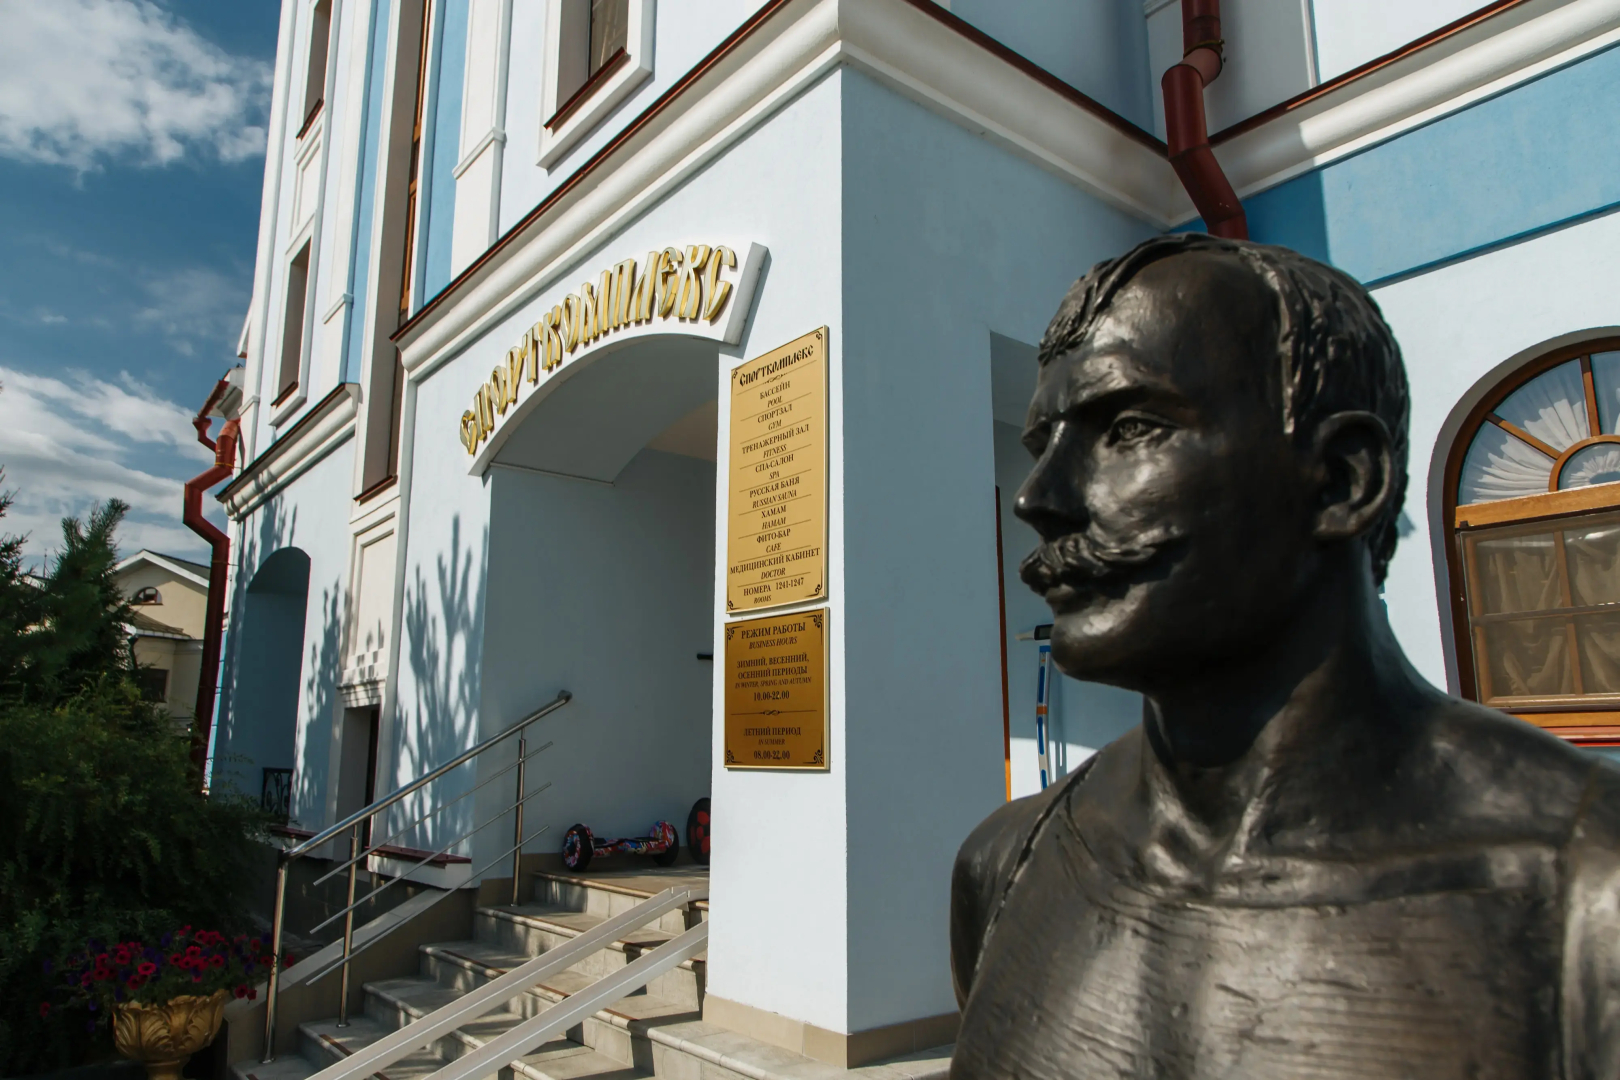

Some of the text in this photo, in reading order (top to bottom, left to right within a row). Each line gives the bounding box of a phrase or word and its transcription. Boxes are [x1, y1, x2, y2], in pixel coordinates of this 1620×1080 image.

[460, 244, 736, 455] СПОРТКОМПЛЕКС
[760, 381, 790, 399] БАССЕЙН
[767, 396, 782, 407] POOL
[758, 404, 792, 423] СПОРТЗАЛ
[768, 419, 781, 430] GYM
[742, 424, 809, 454] ТРЕНАЖЕРНЫЙ ЗАЛ
[763, 444, 787, 458] FITNESS
[755, 454, 794, 473] СПА-САЛОН
[769, 471, 779, 480] SPA
[749, 476, 800, 498] РУССКАЯ БАНЯ
[752, 490, 797, 509] RUSSIAN SAUNA
[761, 505, 787, 518] ХАМАМ
[762, 517, 786, 530] HAMAM
[757, 529, 790, 543] ФИТО-БАР
[766, 543, 781, 553] CAFE
[730, 548, 820, 574] МЕДИЦИНСКИЙ КАБИНЕТ
[761, 568, 785, 579] DOCTOR
[743, 577, 804, 596] НОМЕРА 1241-1247
[754, 595, 771, 604] ROOMS
[741, 622, 805, 639] РЕЖИМ РАБОТЫ
[749, 636, 797, 649] BUSINESS HOURS
[737, 652, 809, 668] ЗИМНИЙ, ВЕСЕННИЙ,
[738, 666, 807, 679] ОСЕННИЙ ПЕРИОДЫ
[760, 679, 777, 687] SPRING
[754, 691, 790, 701] 10.00-22.00
[744, 726, 801, 736] ЛЕТНИЙ ПЕРИОД
[754, 750, 790, 760] 08.00-22.00
